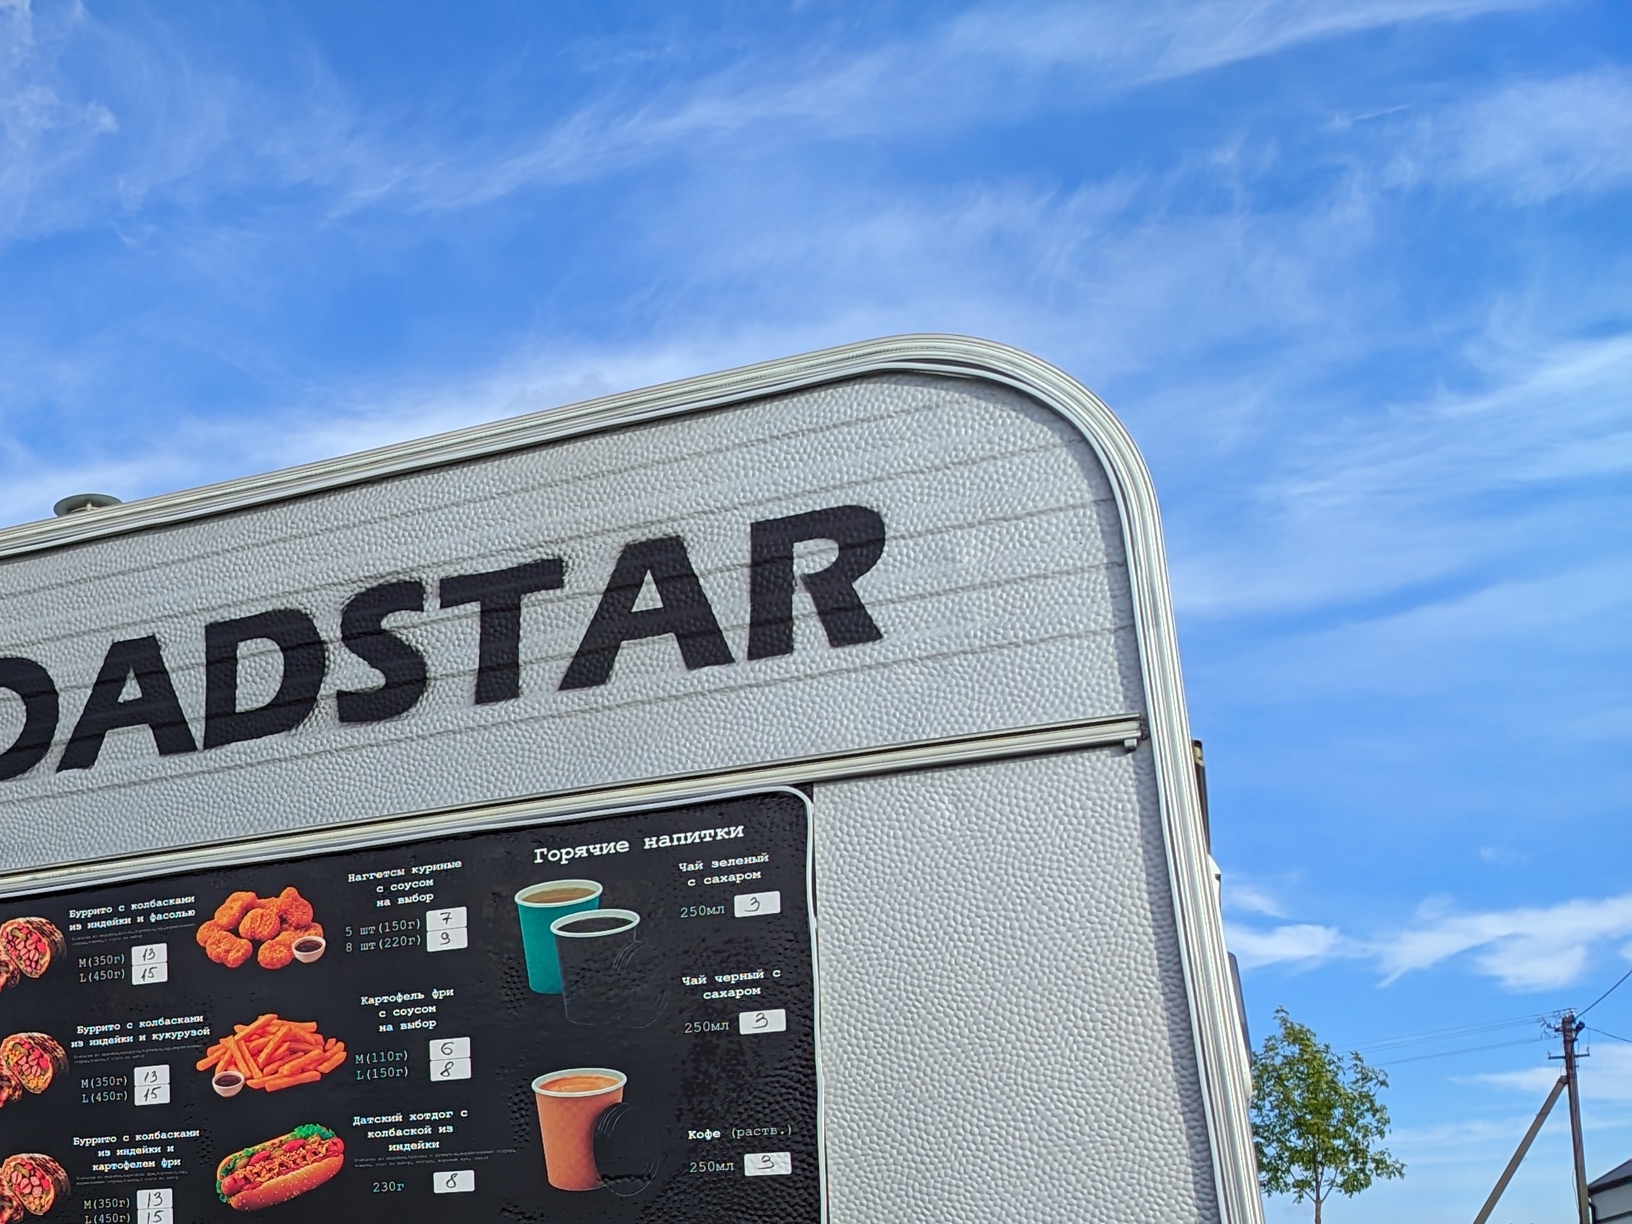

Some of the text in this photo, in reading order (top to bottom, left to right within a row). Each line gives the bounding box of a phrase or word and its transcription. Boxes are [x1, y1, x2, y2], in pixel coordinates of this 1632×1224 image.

[534, 825, 744, 864] Горячие напитки
[678, 852, 769, 872] Чай зеленый
[348, 860, 462, 883] Наггетсы куриные
[376, 879, 434, 893] с соусом
[687, 871, 762, 887] с сахаром
[69, 906, 113, 919] Буррито
[131, 895, 195, 911] колбасками
[376, 893, 434, 907] на выбор
[439, 911, 453, 925] 7
[680, 905, 725, 918] 250мл
[69, 923, 82, 931] из
[87, 917, 132, 929] индейки
[149, 909, 196, 923] фасолью
[345, 926, 353, 937] 5
[439, 931, 451, 945] 9
[345, 942, 353, 953] 8
[142, 948, 156, 962] 13
[141, 966, 157, 981] 15
[681, 968, 781, 986] Чай черный с
[360, 988, 454, 1006] Картофель фри
[703, 987, 761, 1000] сахаром
[378, 1005, 437, 1018] с соусом
[379, 1019, 437, 1032] на выбор
[684, 1021, 729, 1034] 250мл
[71, 1026, 210, 1048] из индейки и кукурузой
[440, 1041, 454, 1056] 6
[144, 1070, 158, 1083] 13
[440, 1061, 454, 1078] 8
[143, 1086, 161, 1102] 15
[352, 1112, 403, 1126] Датский
[409, 1111, 454, 1121] хотдог
[367, 1125, 454, 1138] колбаской из
[687, 1124, 792, 1141] Кофе (раств.)
[388, 1140, 440, 1152] индейки
[92, 1157, 181, 1173] картофелем фри
[689, 1160, 735, 1173] 250мл
[373, 1181, 405, 1193] 230г
[445, 1172, 459, 1189] 8
[146, 1191, 164, 1208] 13
[146, 1210, 165, 1224] 15
